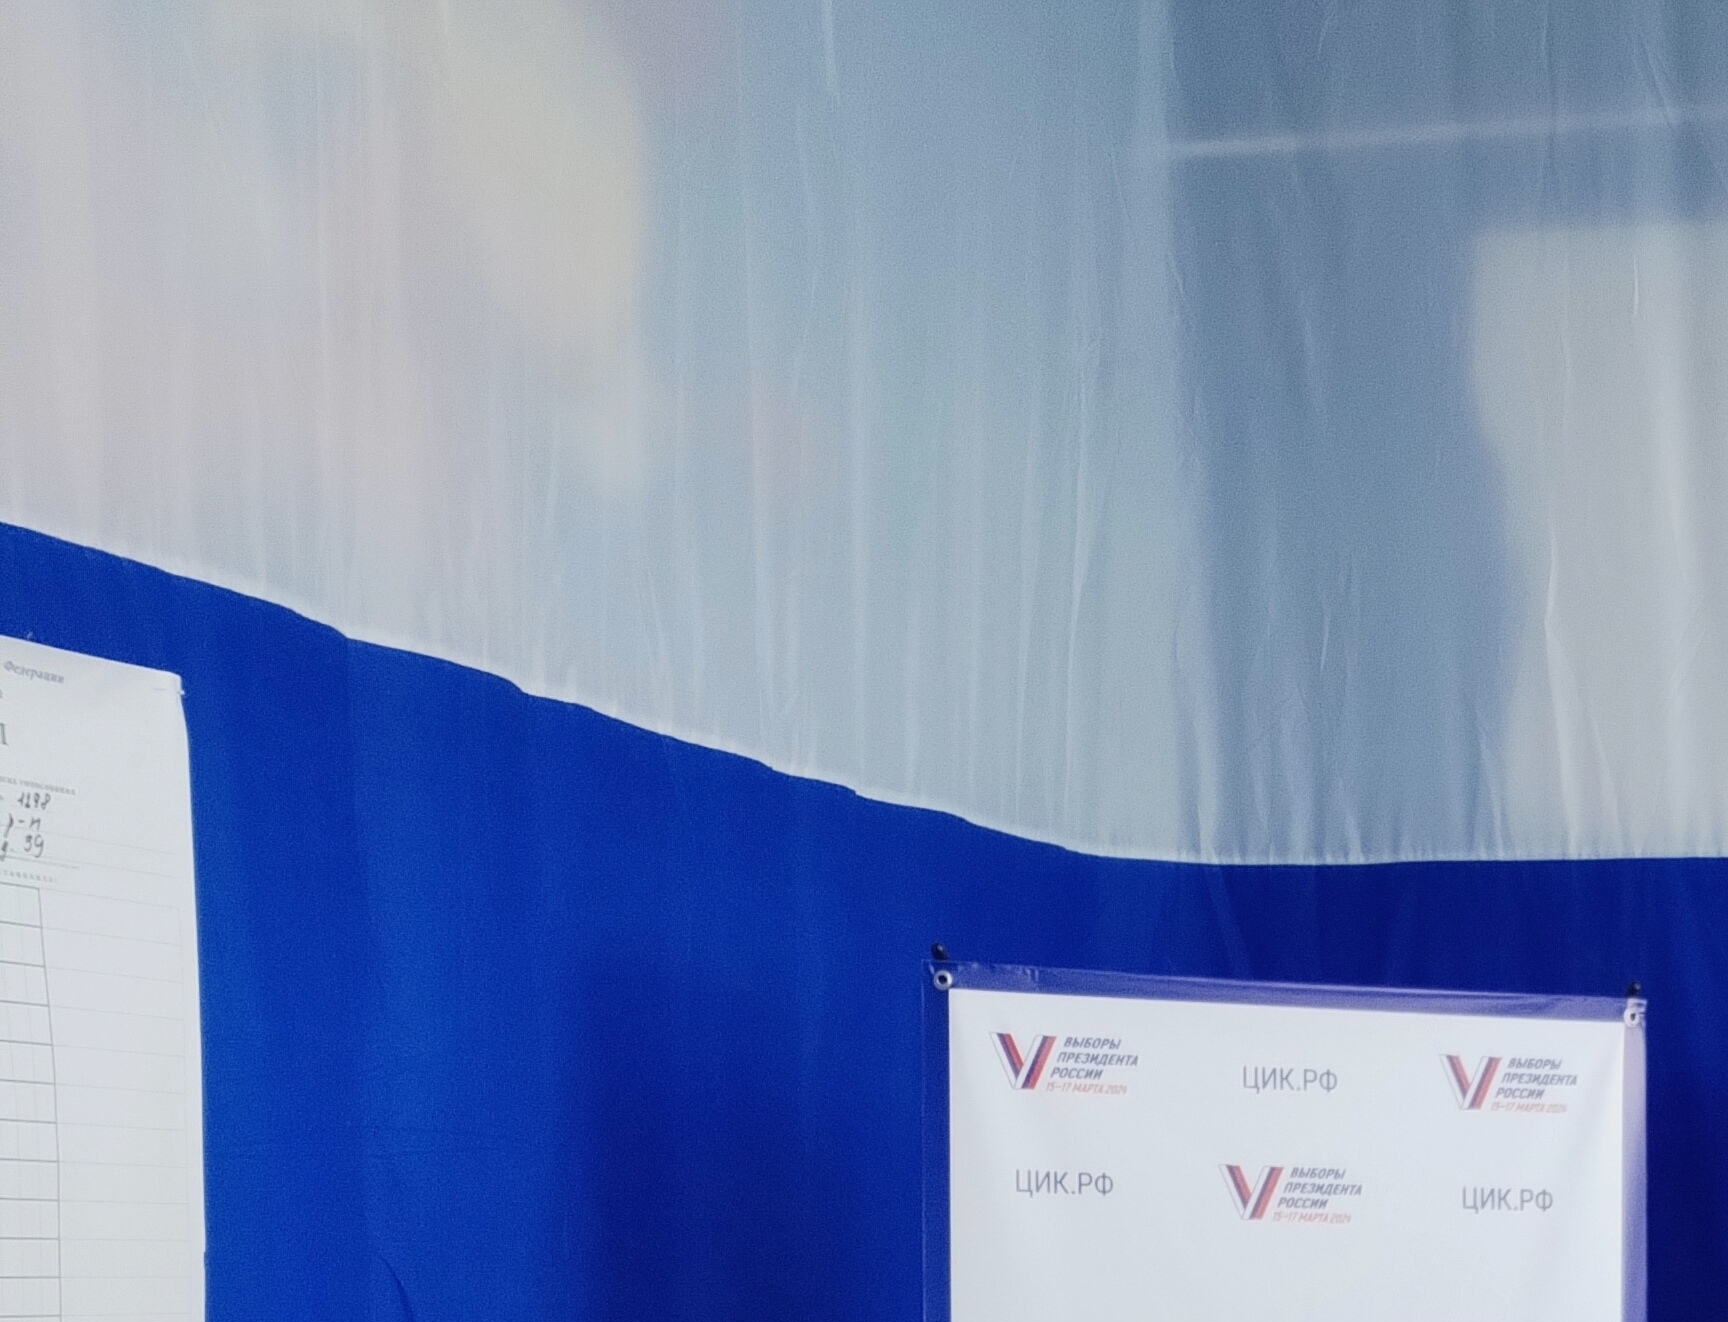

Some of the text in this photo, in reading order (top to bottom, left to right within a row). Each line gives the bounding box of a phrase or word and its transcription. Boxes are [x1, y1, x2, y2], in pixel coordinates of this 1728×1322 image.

[1065, 1037, 1122, 1050] ВЫБОРЫ
[1058, 1052, 1138, 1067] ПРЕЗИДЕНТА
[1509, 1058, 1563, 1070] ВЫБОРЫ
[1052, 1067, 1104, 1080] РОССИИ
[1243, 1066, 1338, 1094] ЦИК.РФ
[1503, 1073, 1577, 1086] ПРЕЗИДЕНТА
[1497, 1088, 1545, 1099] РОССИИ
[1291, 1168, 1347, 1180] ВЫБОРЫ
[1016, 1169, 1114, 1198] ЦИК.РФ
[1285, 1183, 1362, 1196] ПРЕЗИДЕНТА
[1279, 1197, 1329, 1209] РОССИИ
[1462, 1187, 1554, 1214] ЦИК.РФ
